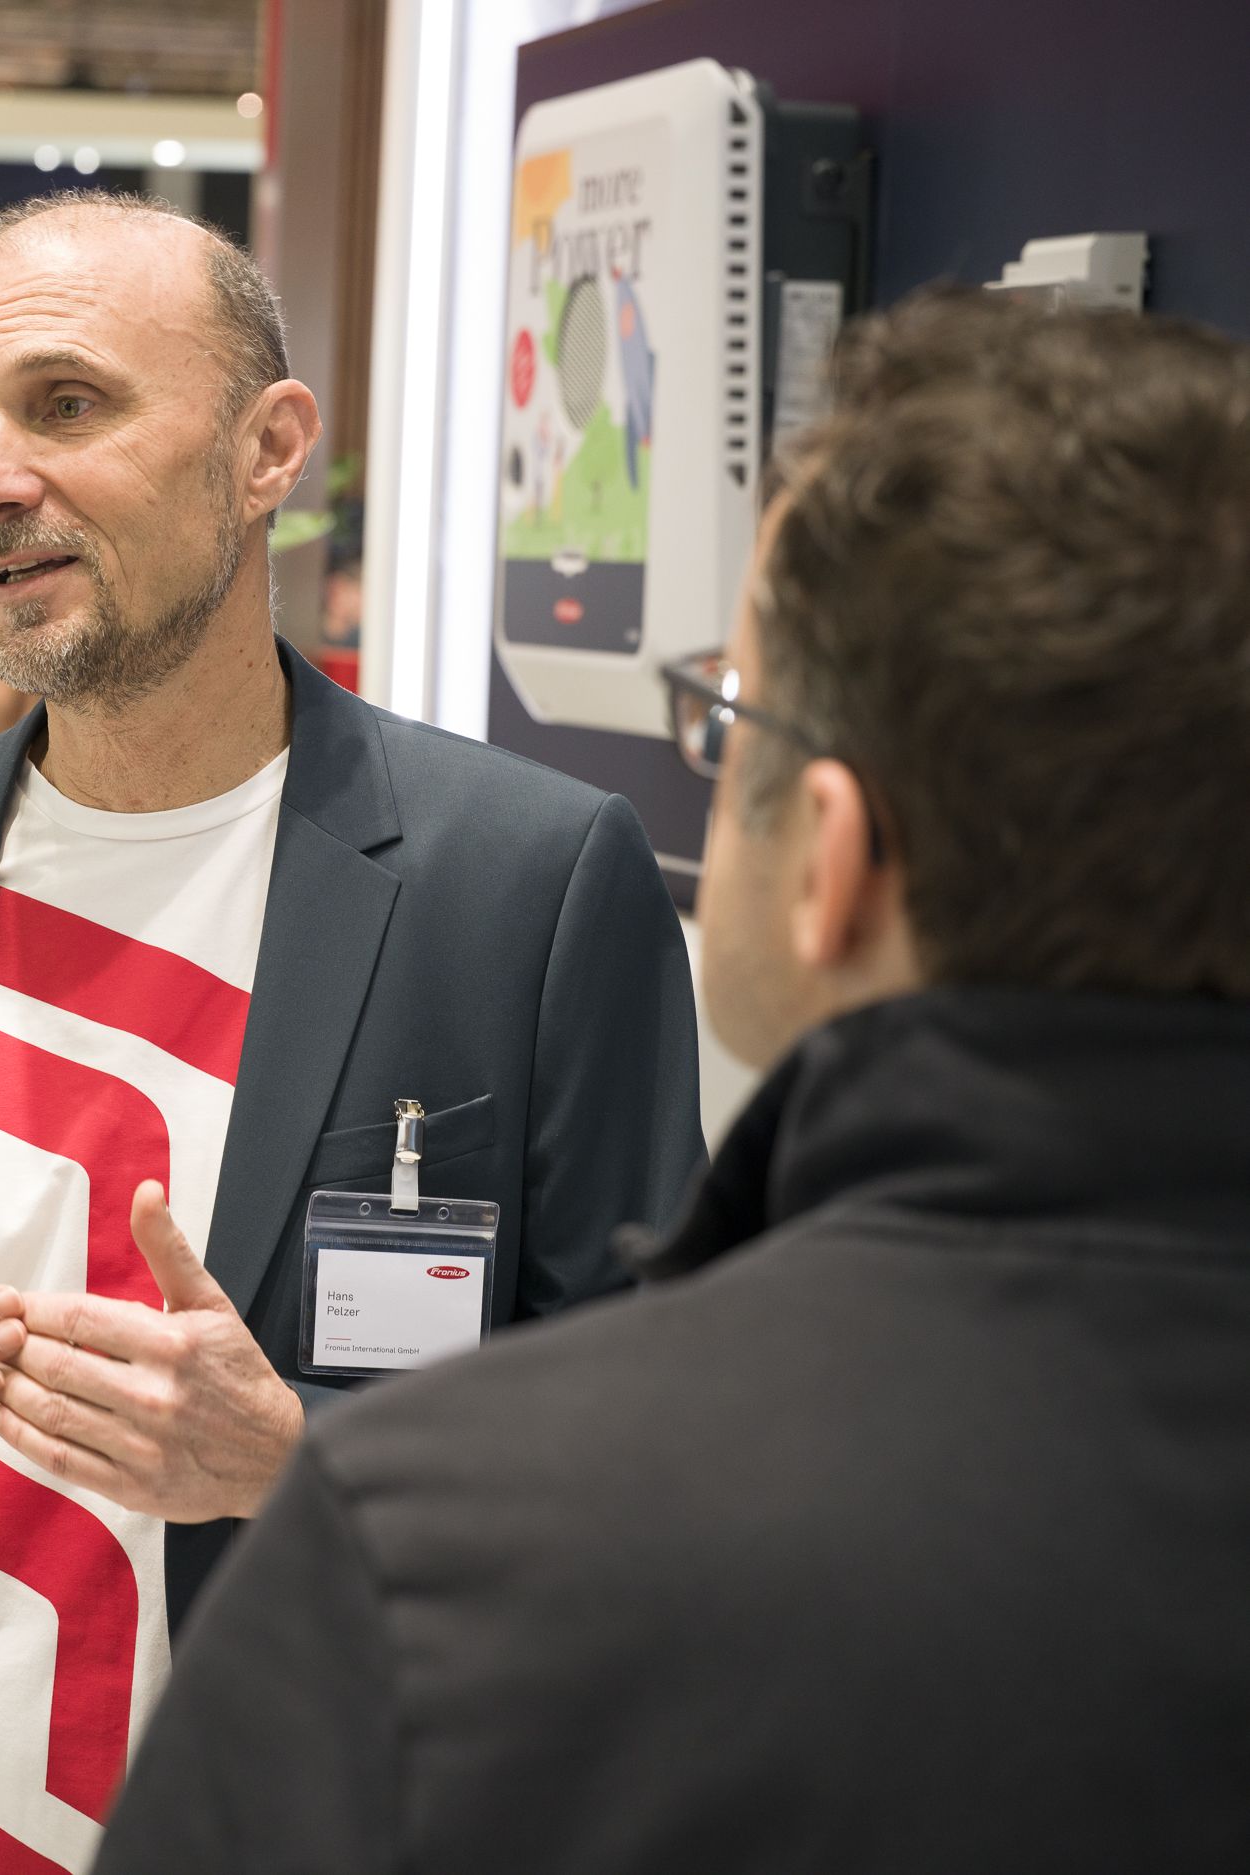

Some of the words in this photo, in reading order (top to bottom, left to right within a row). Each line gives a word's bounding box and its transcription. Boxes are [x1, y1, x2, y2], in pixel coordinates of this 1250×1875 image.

[578, 168, 641, 214] more
[530, 216, 652, 296] Power
[430, 1266, 468, 1278] Fronius
[327, 1290, 354, 1302] Hans
[326, 1305, 361, 1317] Pelzer
[324, 1343, 351, 1352] Fronius
[352, 1345, 396, 1354] International
[397, 1347, 420, 1355] GmbH
